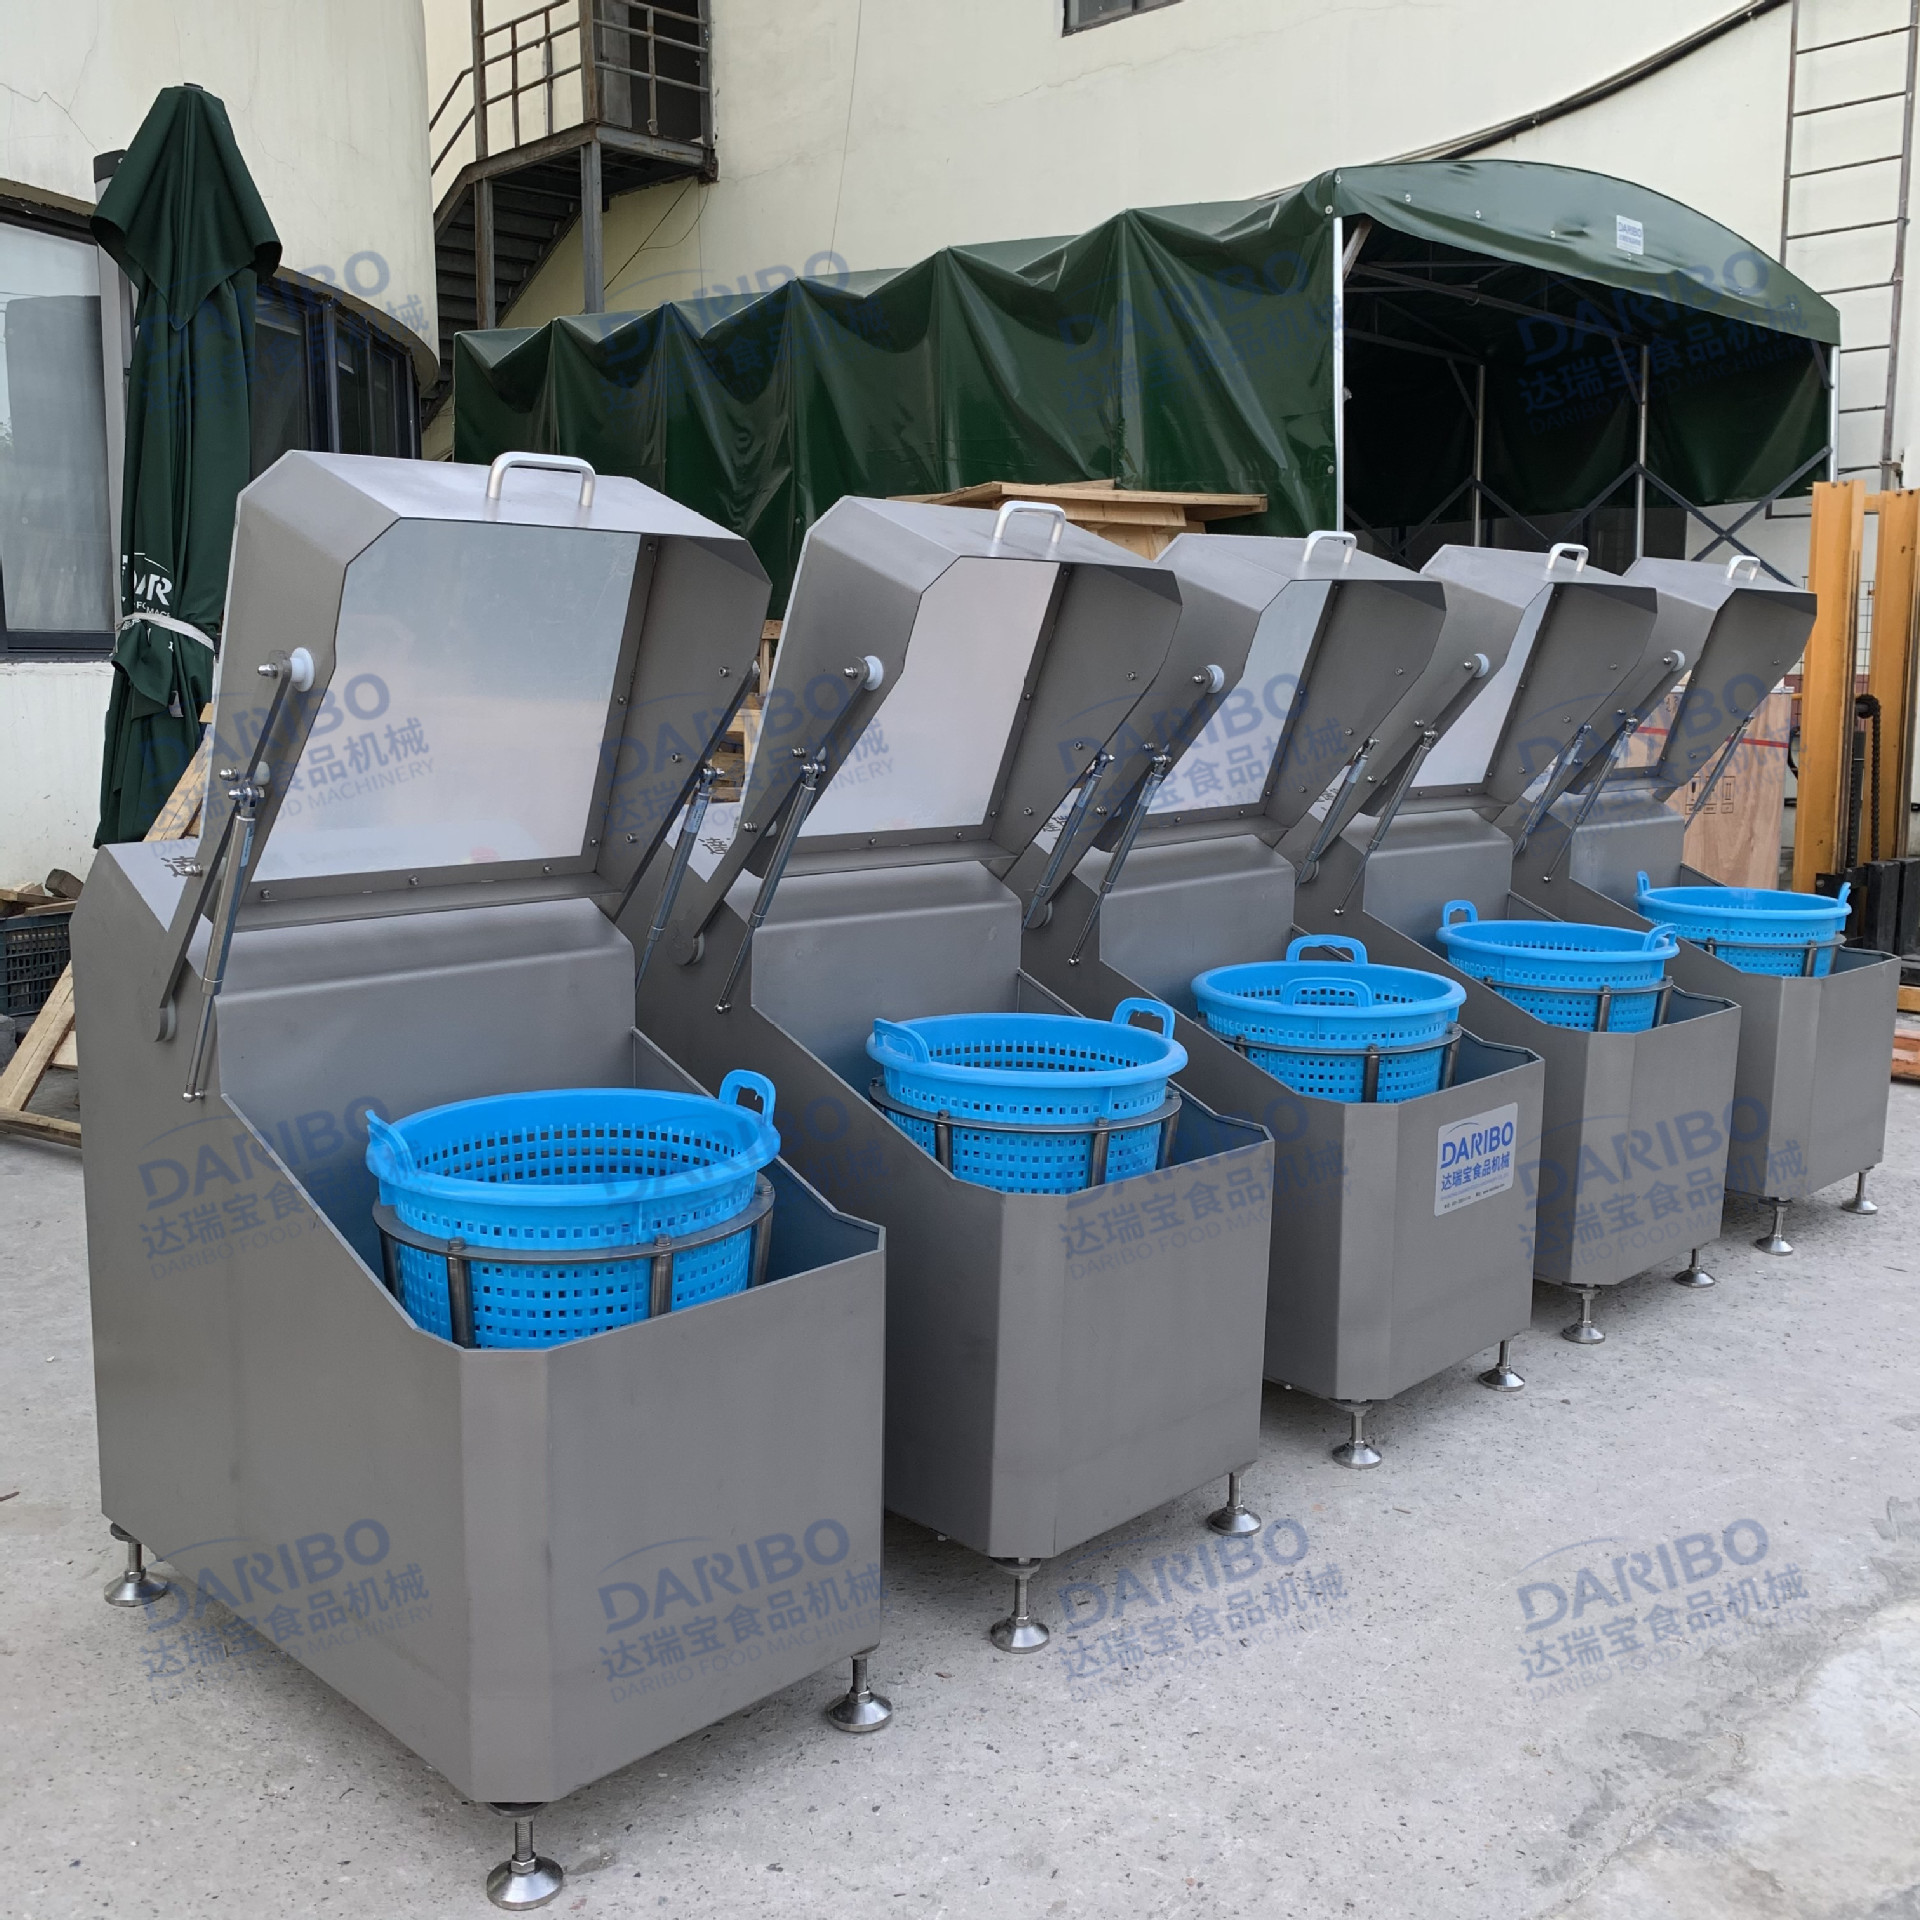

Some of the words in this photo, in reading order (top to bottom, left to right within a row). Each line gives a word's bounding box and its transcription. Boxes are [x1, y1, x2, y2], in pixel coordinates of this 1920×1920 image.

[1440, 1121, 1514, 1169] DARIBO
[1441, 1151, 1510, 1192] 达瑞宝食品机械
